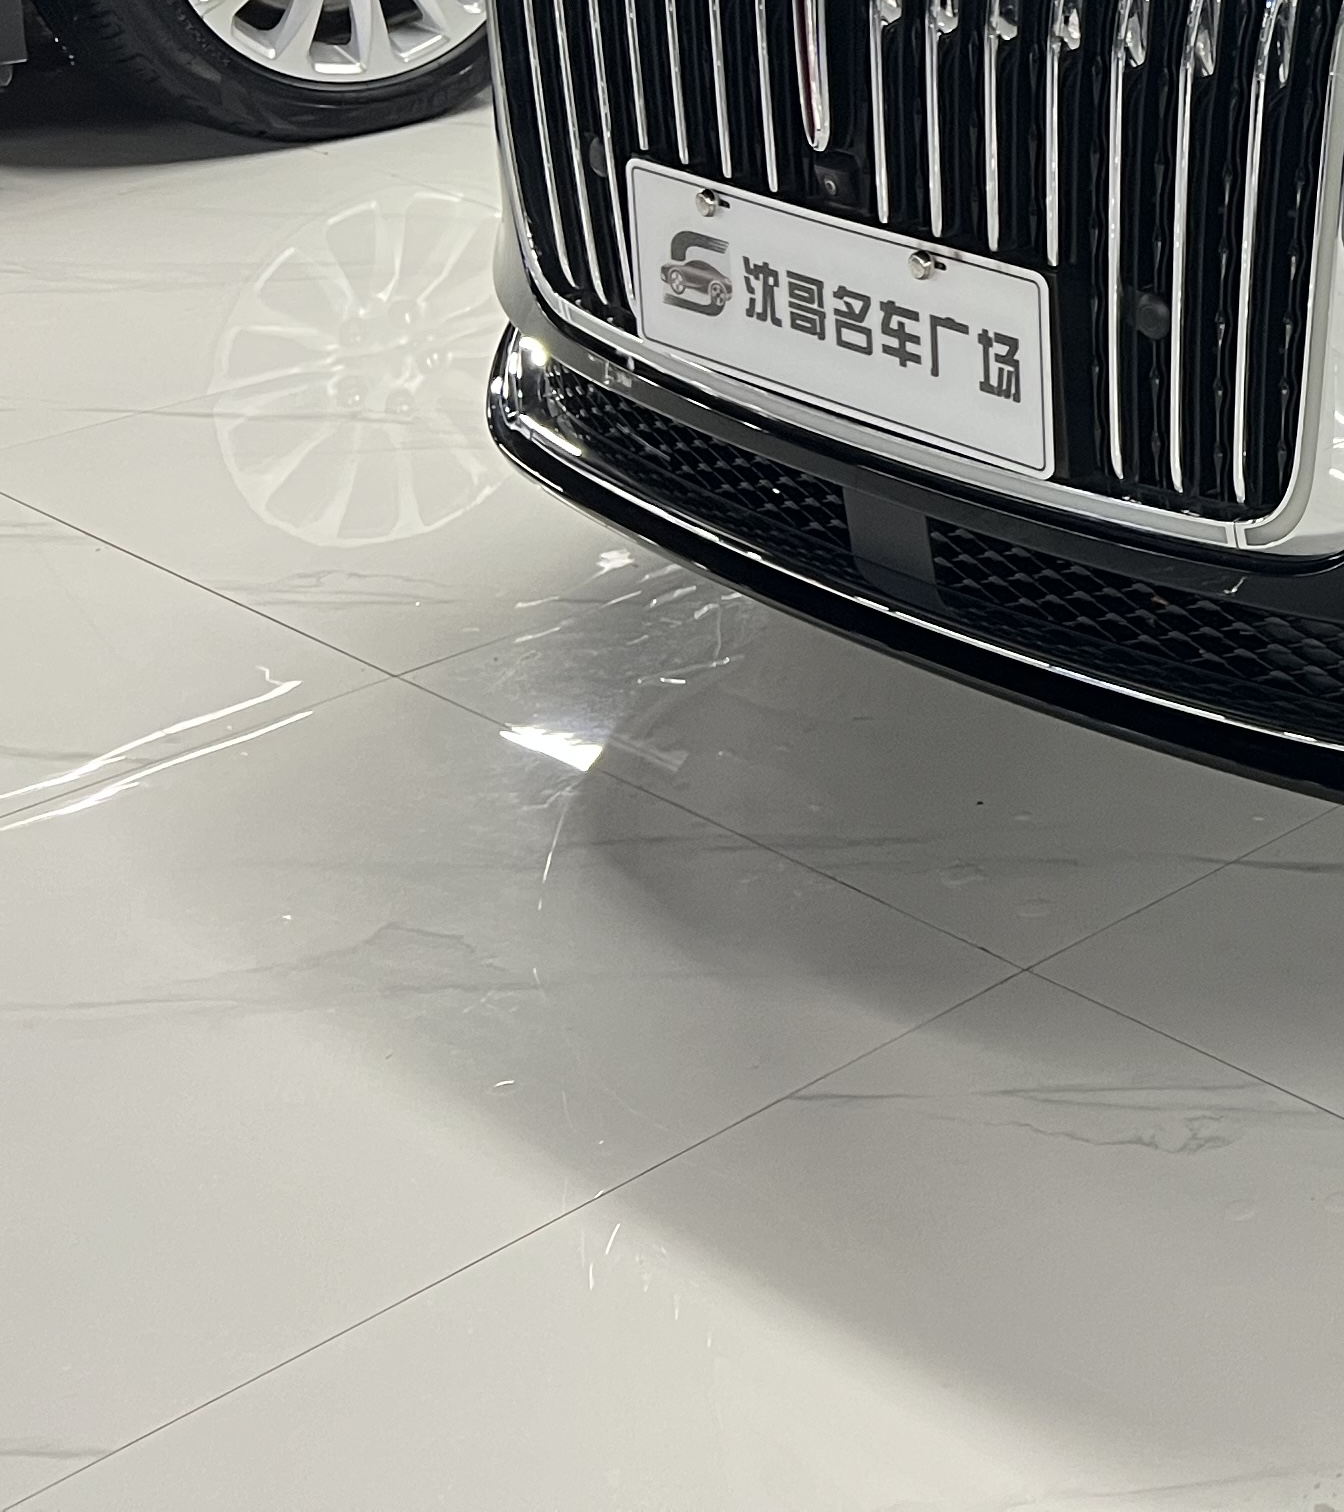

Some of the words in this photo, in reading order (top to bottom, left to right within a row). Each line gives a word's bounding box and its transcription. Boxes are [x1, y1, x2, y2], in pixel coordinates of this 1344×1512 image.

[742, 255, 1022, 404] 沈哥名车广场
